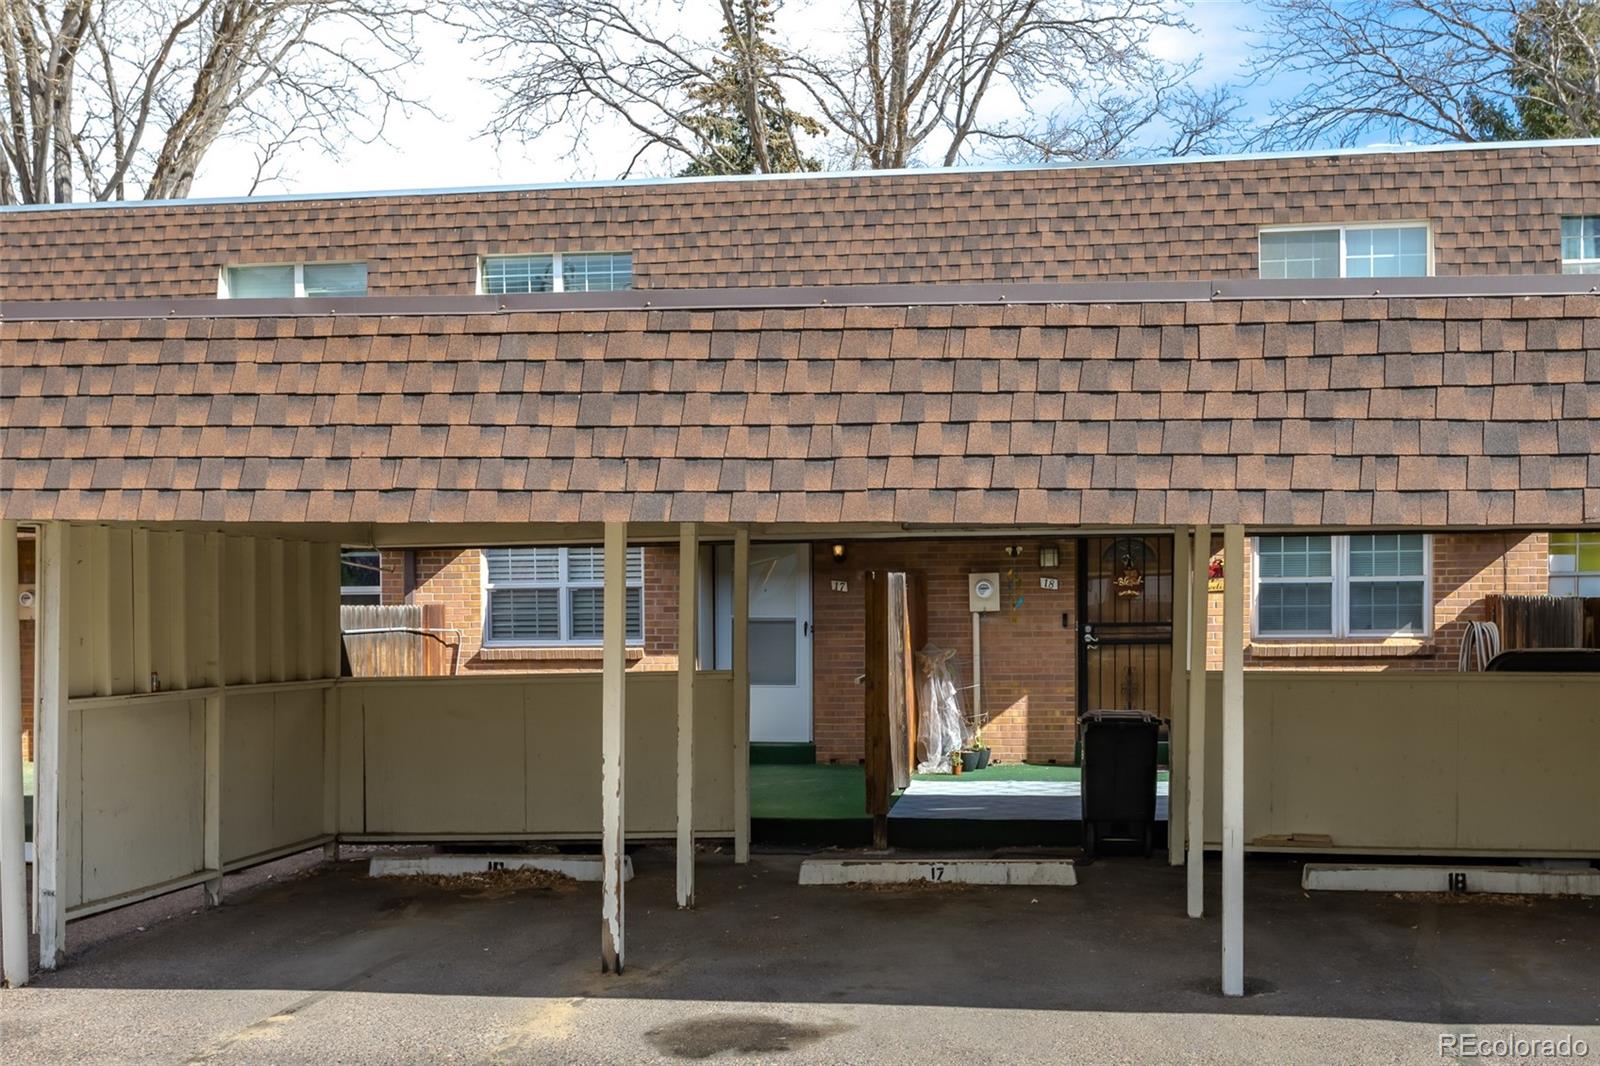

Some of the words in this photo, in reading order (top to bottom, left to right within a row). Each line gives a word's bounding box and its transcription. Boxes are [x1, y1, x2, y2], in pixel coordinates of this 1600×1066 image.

[835, 581, 846, 592] 17
[1044, 578, 1056, 589] 18
[931, 867, 945, 881] 17
[1448, 872, 1467, 892] 18
